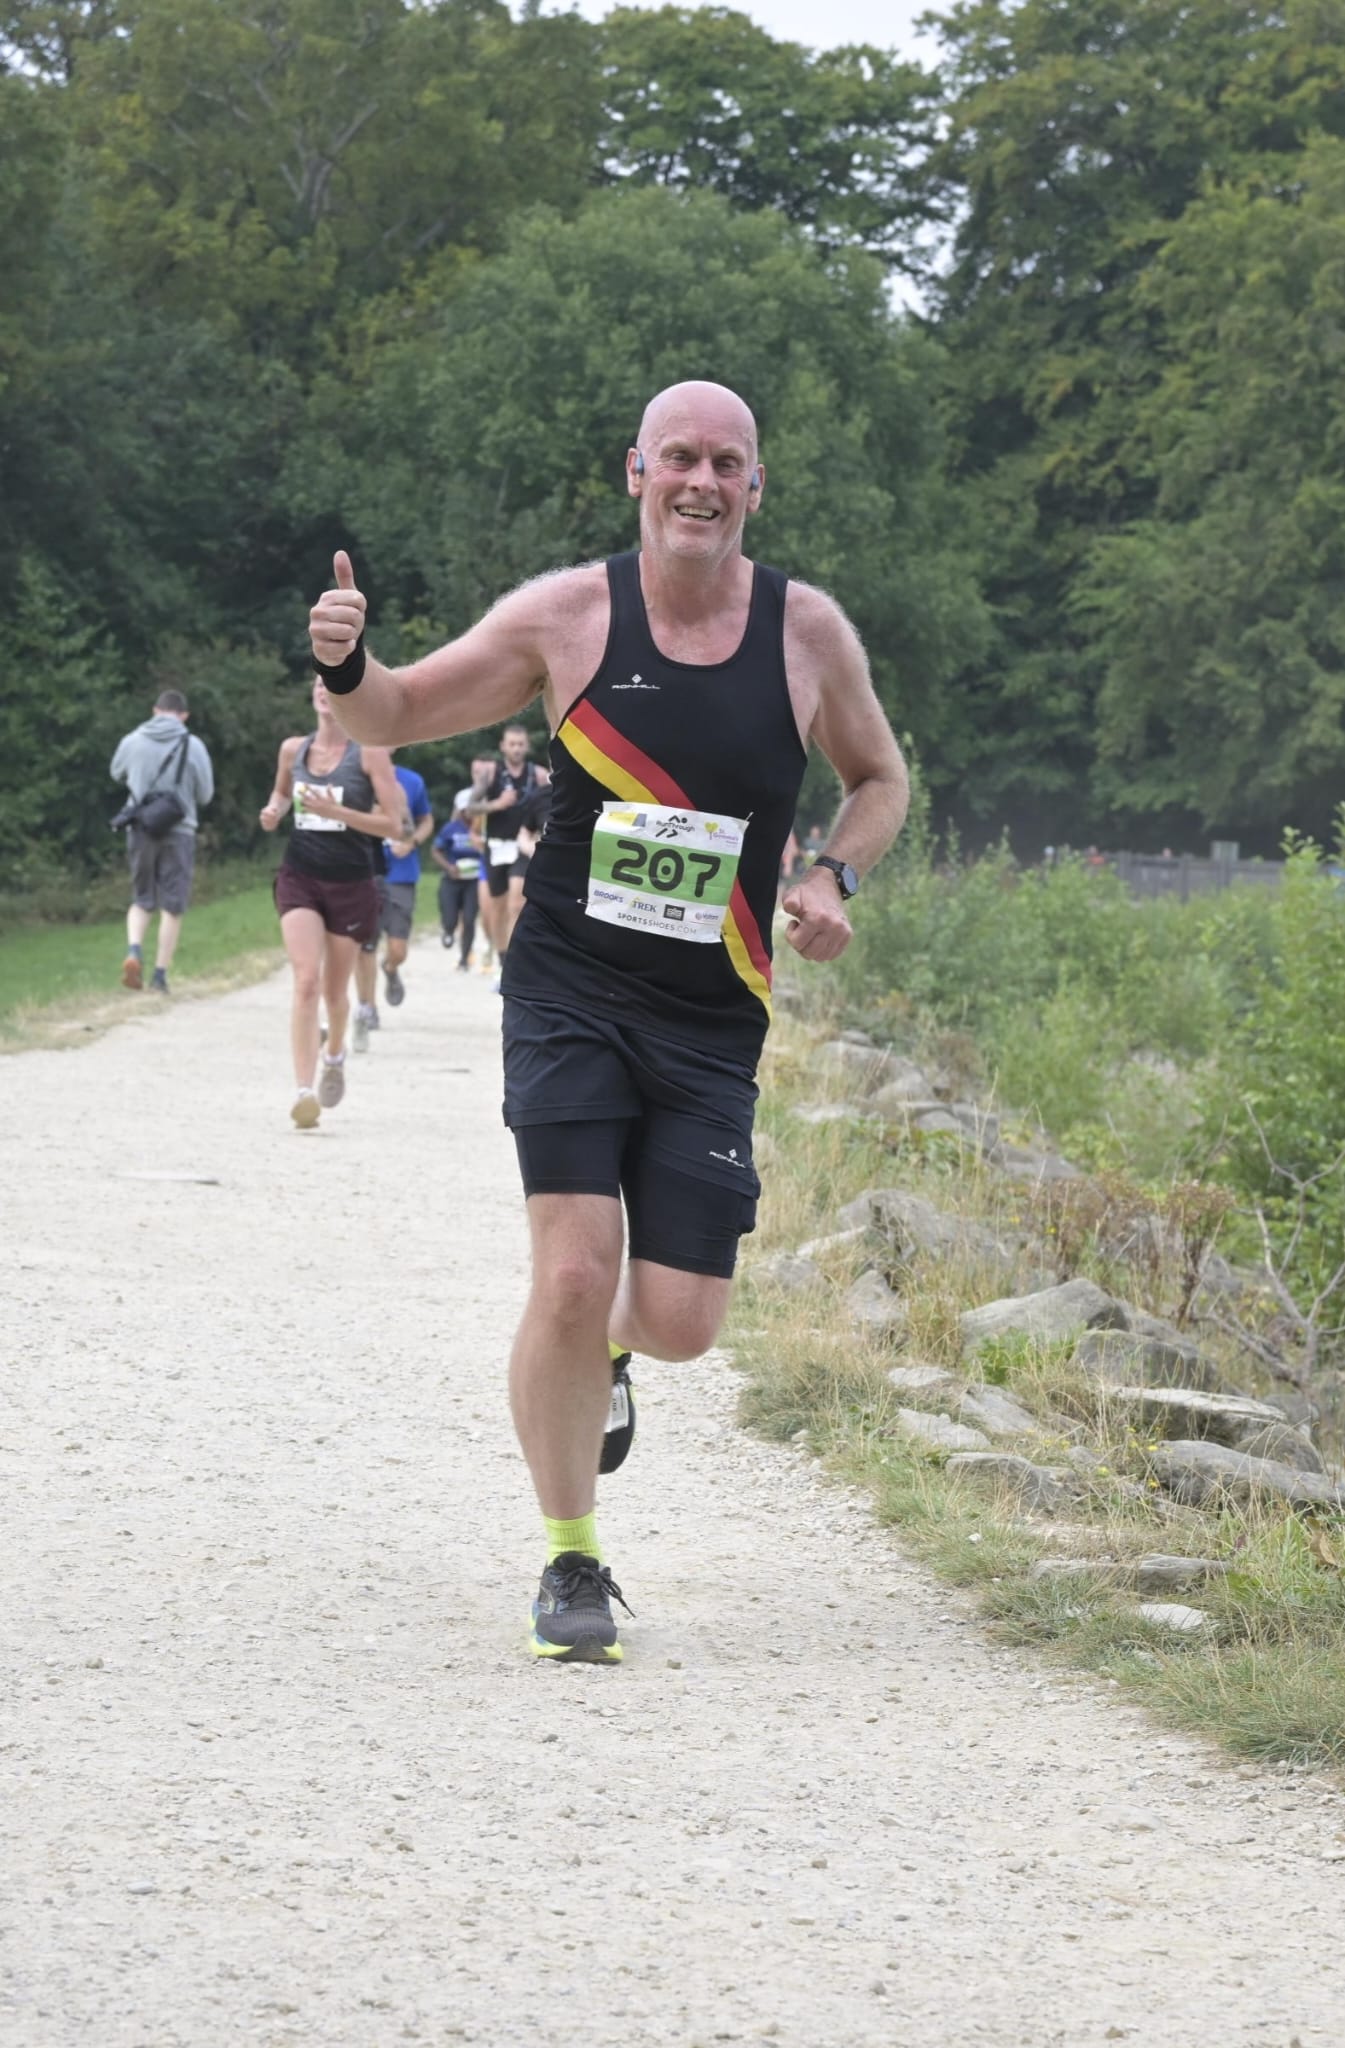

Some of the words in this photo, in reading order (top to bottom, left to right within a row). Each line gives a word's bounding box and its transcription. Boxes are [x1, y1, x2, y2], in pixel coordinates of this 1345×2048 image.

[611, 839, 721, 898] 207
[593, 889, 624, 903] BROOKS
[632, 901, 657, 913] TREK
[617, 912, 697, 935] SPORTSSHOES.COM
